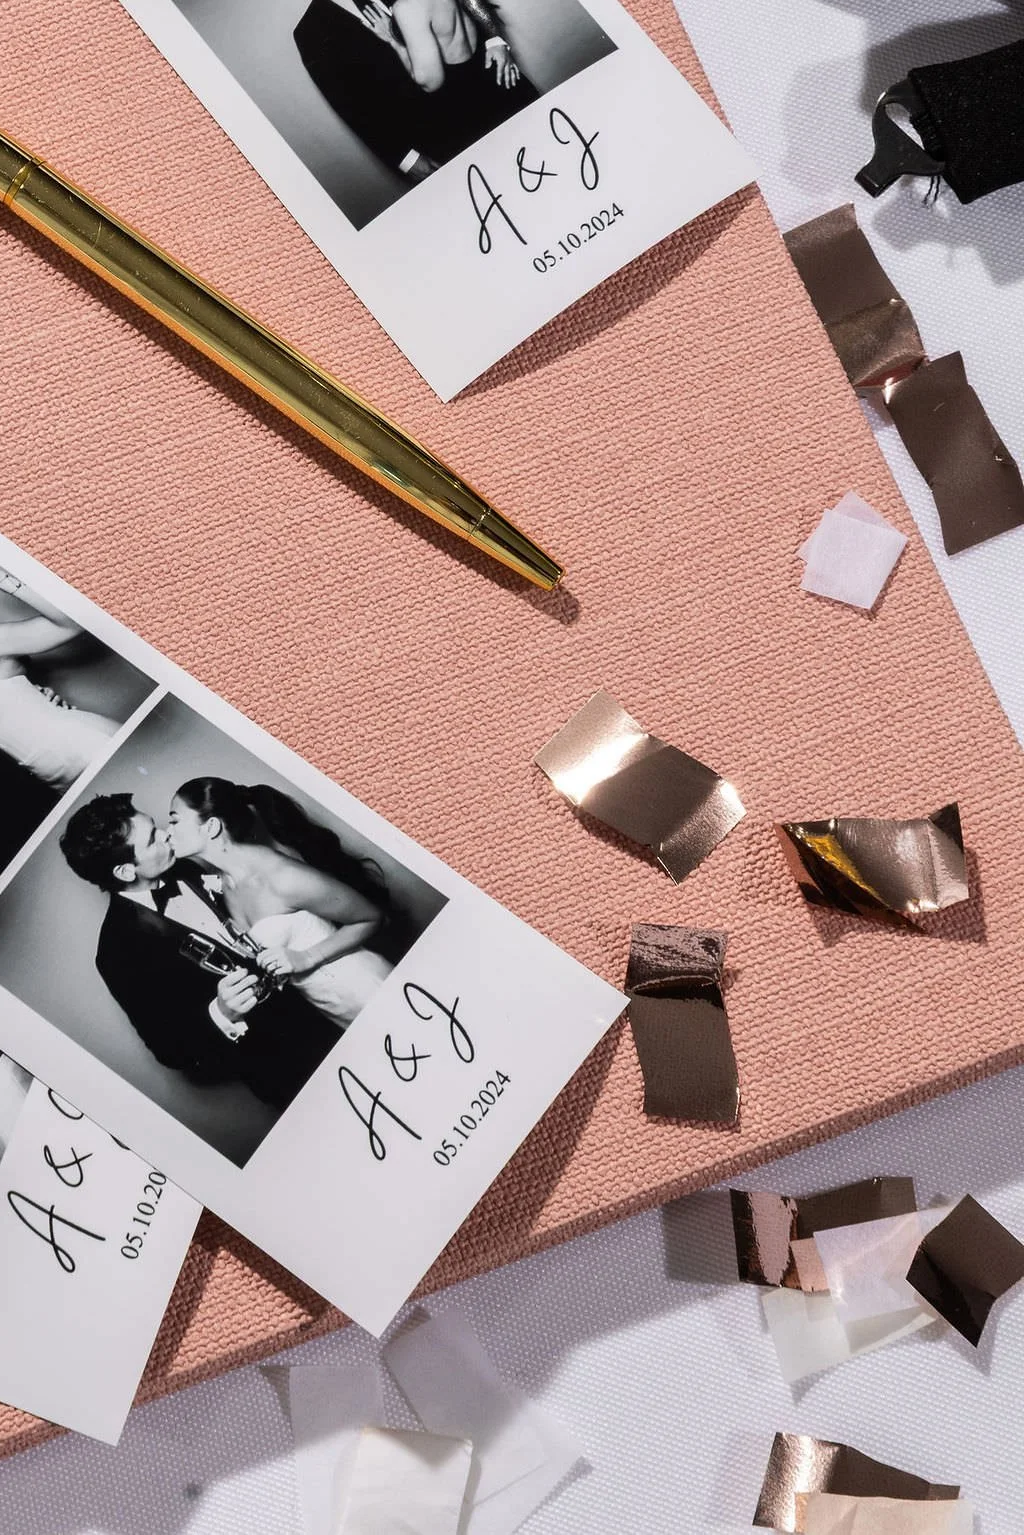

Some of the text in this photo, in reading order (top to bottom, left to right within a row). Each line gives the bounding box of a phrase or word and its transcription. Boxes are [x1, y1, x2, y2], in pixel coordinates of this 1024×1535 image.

[467, 107, 600, 254] A & J
[532, 202, 625, 274] 05.10.2024
[338, 982, 475, 1161] A & J
[432, 1069, 511, 1167] 05.10.2024
[44, 1144, 93, 1188] &
[7, 1190, 106, 1273] A
[120, 1169, 168, 1260] 05.10.20
